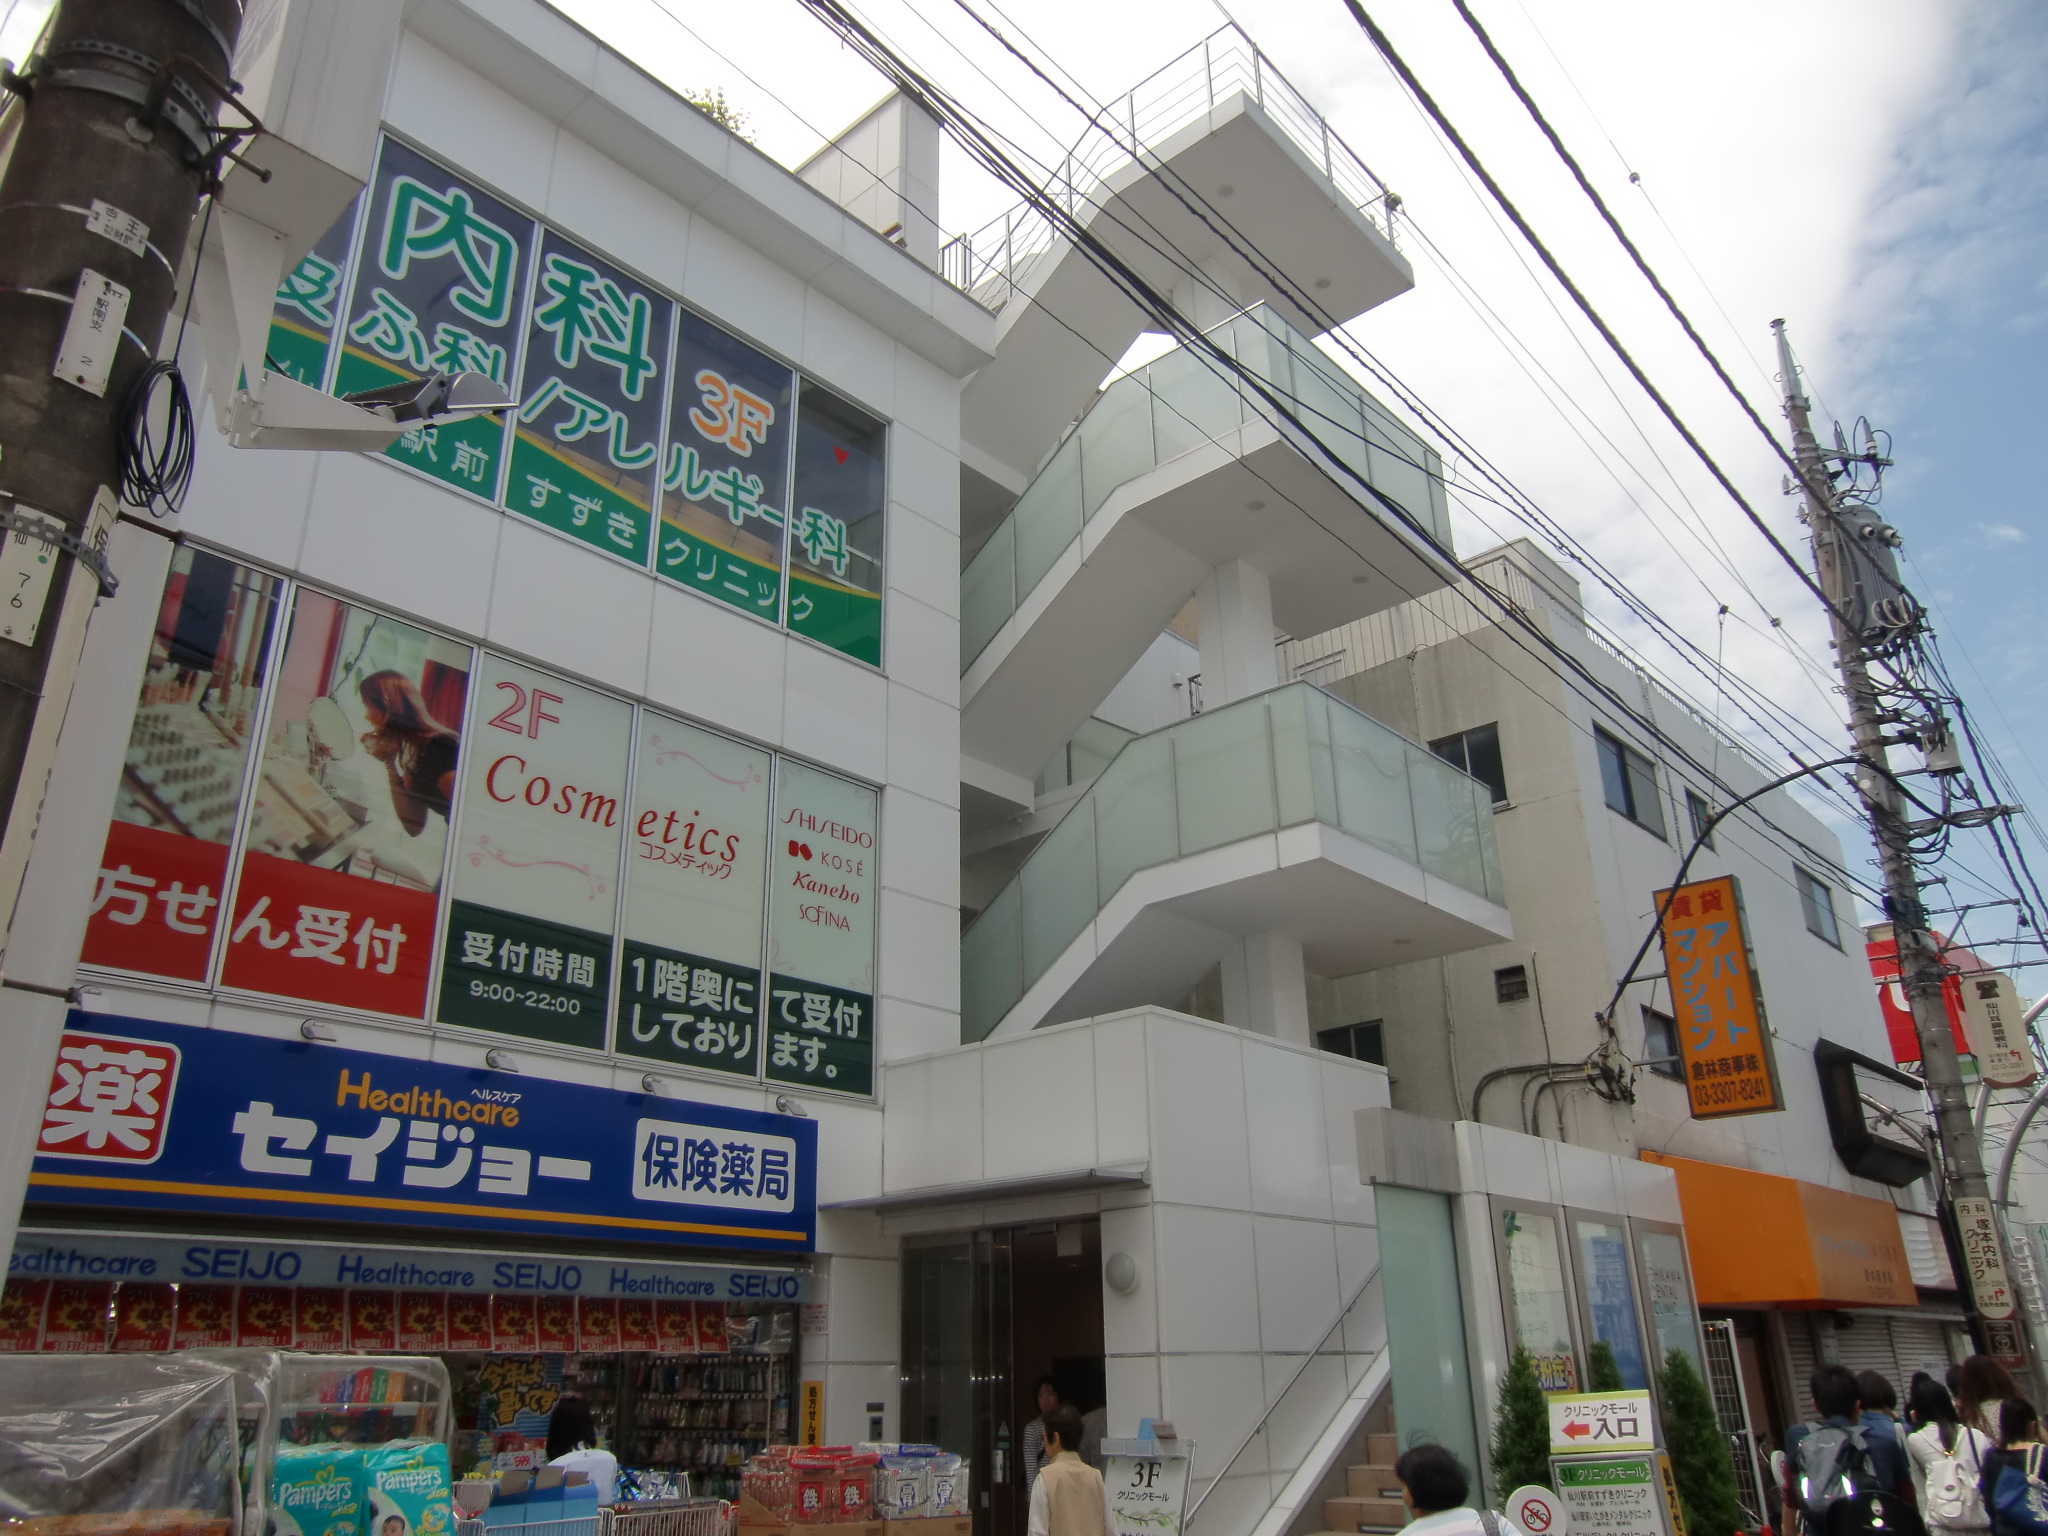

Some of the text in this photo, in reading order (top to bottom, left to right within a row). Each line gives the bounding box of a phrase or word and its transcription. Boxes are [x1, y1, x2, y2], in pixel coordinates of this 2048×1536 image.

[379, 175, 657, 401] 内科
[689, 369, 775, 457] 3F
[488, 681, 564, 740] 2F
[486, 755, 741, 863] Cosmetics
[780, 808, 873, 849] SHISEIDO
[639, 841, 733, 880] コスメティック
[792, 870, 861, 905] Kanebo
[461, 930, 596, 989] 受付時間
[1671, 928, 1716, 1051] マンション
[43, 1044, 167, 1152] 薬
[336, 1068, 521, 1128] Healthcare
[470, 1087, 522, 1104] ヘルスケア
[231, 1100, 592, 1196] セイジョー
[641, 1131, 790, 1201] 保険薬局
[1959, 1203, 1987, 1215] 内科
[180, 1246, 302, 1280] SEIJO
[336, 1253, 475, 1287] Healthcare
[491, 1262, 582, 1291] SEIJO
[609, 1267, 715, 1297] Healthcare
[728, 1273, 799, 1299] SEIJO
[1965, 1228, 1985, 1280] クリニック
[1563, 1401, 1638, 1418] クリニックモール
[1592, 1417, 1640, 1441] 入口
[278, 1482, 353, 1509] Pampers
[375, 1470, 443, 1492] Pampers
[1116, 1490, 1170, 1503] クリニックモール
[1131, 1462, 1162, 1488] 3F
[1577, 1466, 1646, 1482] クリニックモール
